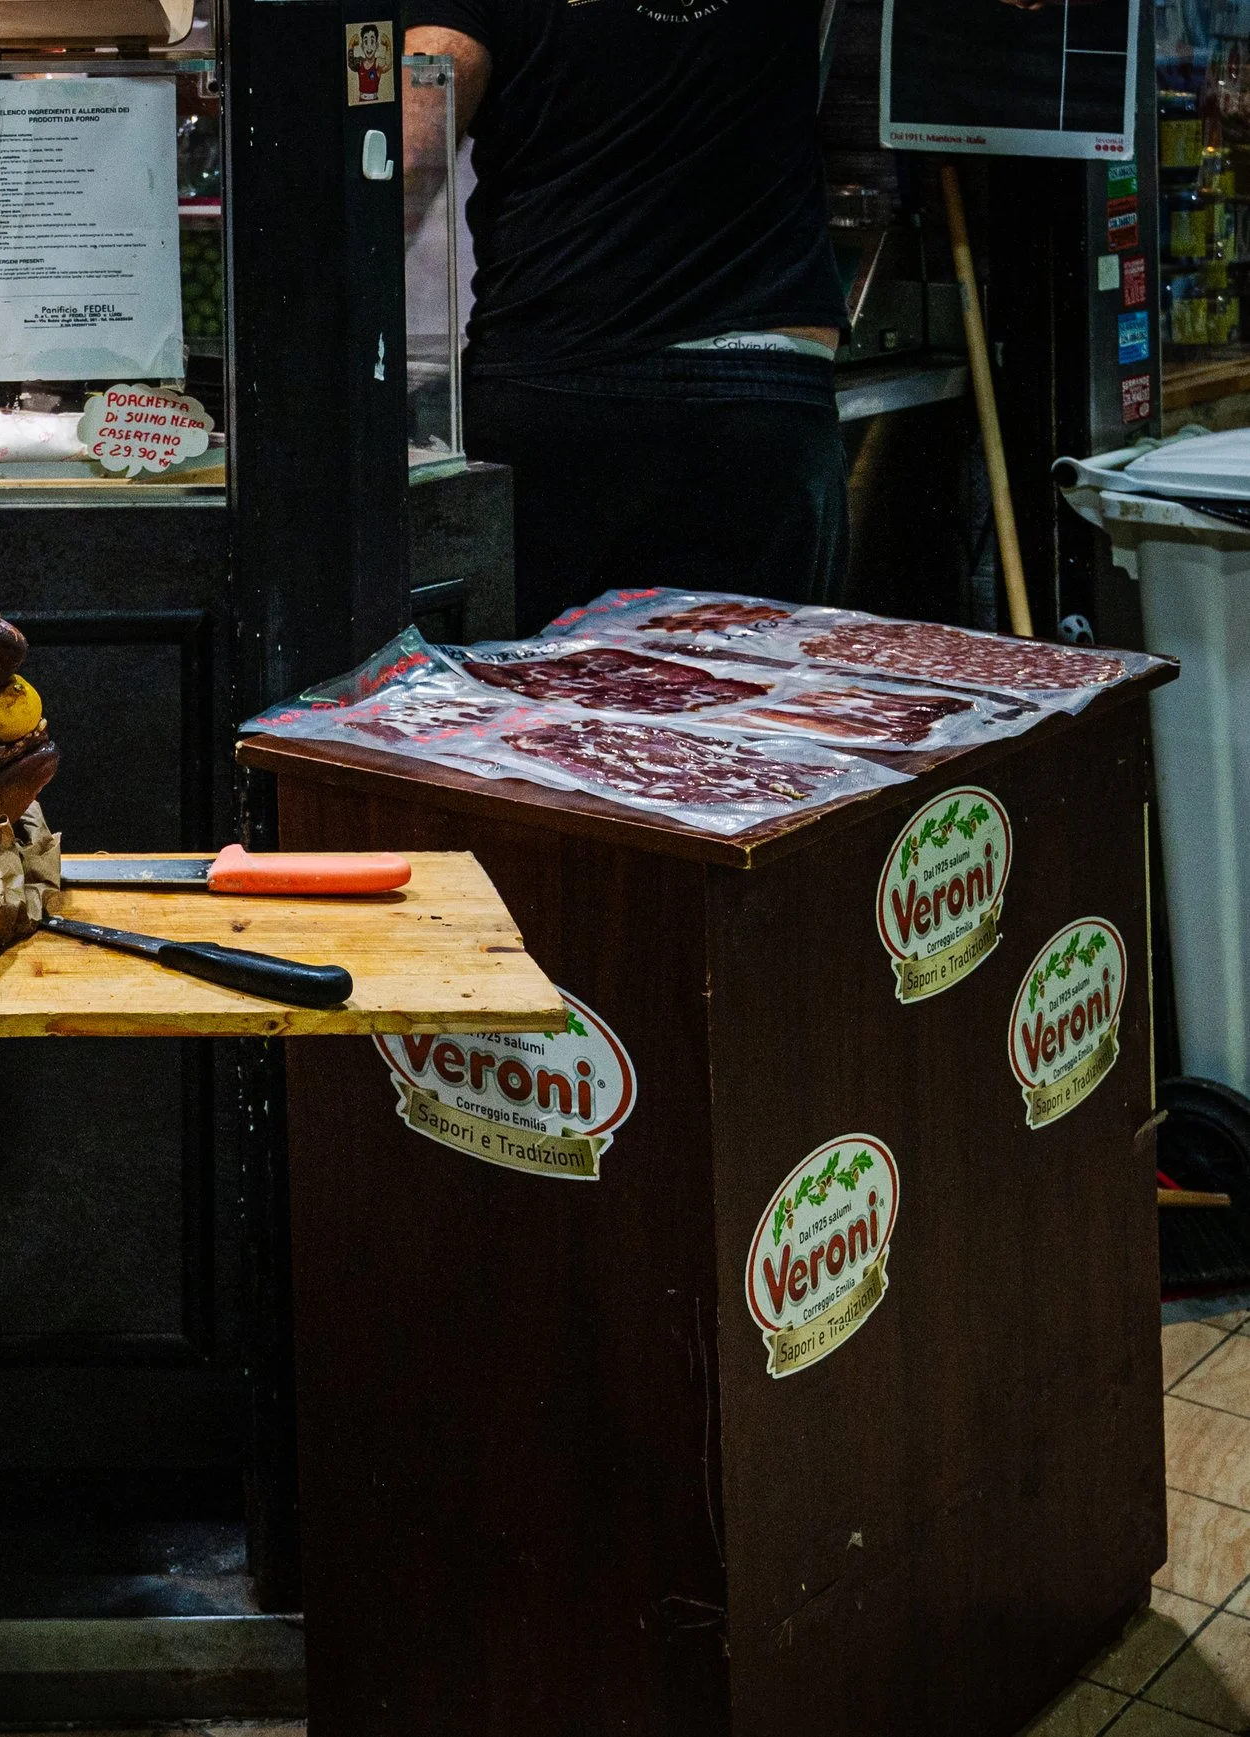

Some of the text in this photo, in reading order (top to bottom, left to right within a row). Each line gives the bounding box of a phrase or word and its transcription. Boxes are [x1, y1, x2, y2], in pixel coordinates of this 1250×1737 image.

[636, 4, 719, 23] L'AQUILA DAL
[27, 108, 71, 116] INGREDIENTI
[78, 107, 117, 115] ALLERGENI
[41, 304, 115, 314] Panificio FEDELI
[713, 337, 761, 350] Calvin
[107, 392, 190, 412] PORCHETTA
[124, 412, 167, 426] SUINO
[170, 415, 205, 429] NERO
[98, 427, 181, 446] CASERTANO
[923, 848, 970, 882] Dal 1925 salumi
[891, 842, 993, 945] Veroni
[926, 921, 973, 954] Correggio Emilia
[907, 931, 992, 991] Sapori e Tradizioni
[1059, 990, 1071, 1008] 1925
[1071, 975, 1090, 997] salumi
[1021, 966, 1111, 1073] Veroni
[503, 1036, 545, 1056] salumi
[1052, 1043, 1094, 1080] Correggio Emilia
[402, 1033, 593, 1122] Veroni
[1036, 1050, 1111, 1116] Sapori e Tradizioni
[456, 1096, 547, 1133] Correggio Emilia
[417, 1103, 586, 1168] Sapori e Tradizioni
[799, 1200, 852, 1245] Dal 1925 salumi
[762, 1190, 878, 1315] Veroni
[803, 1277, 856, 1321] Correggio Emilia
[780, 1284, 877, 1363] Sapori e Tradizioni
